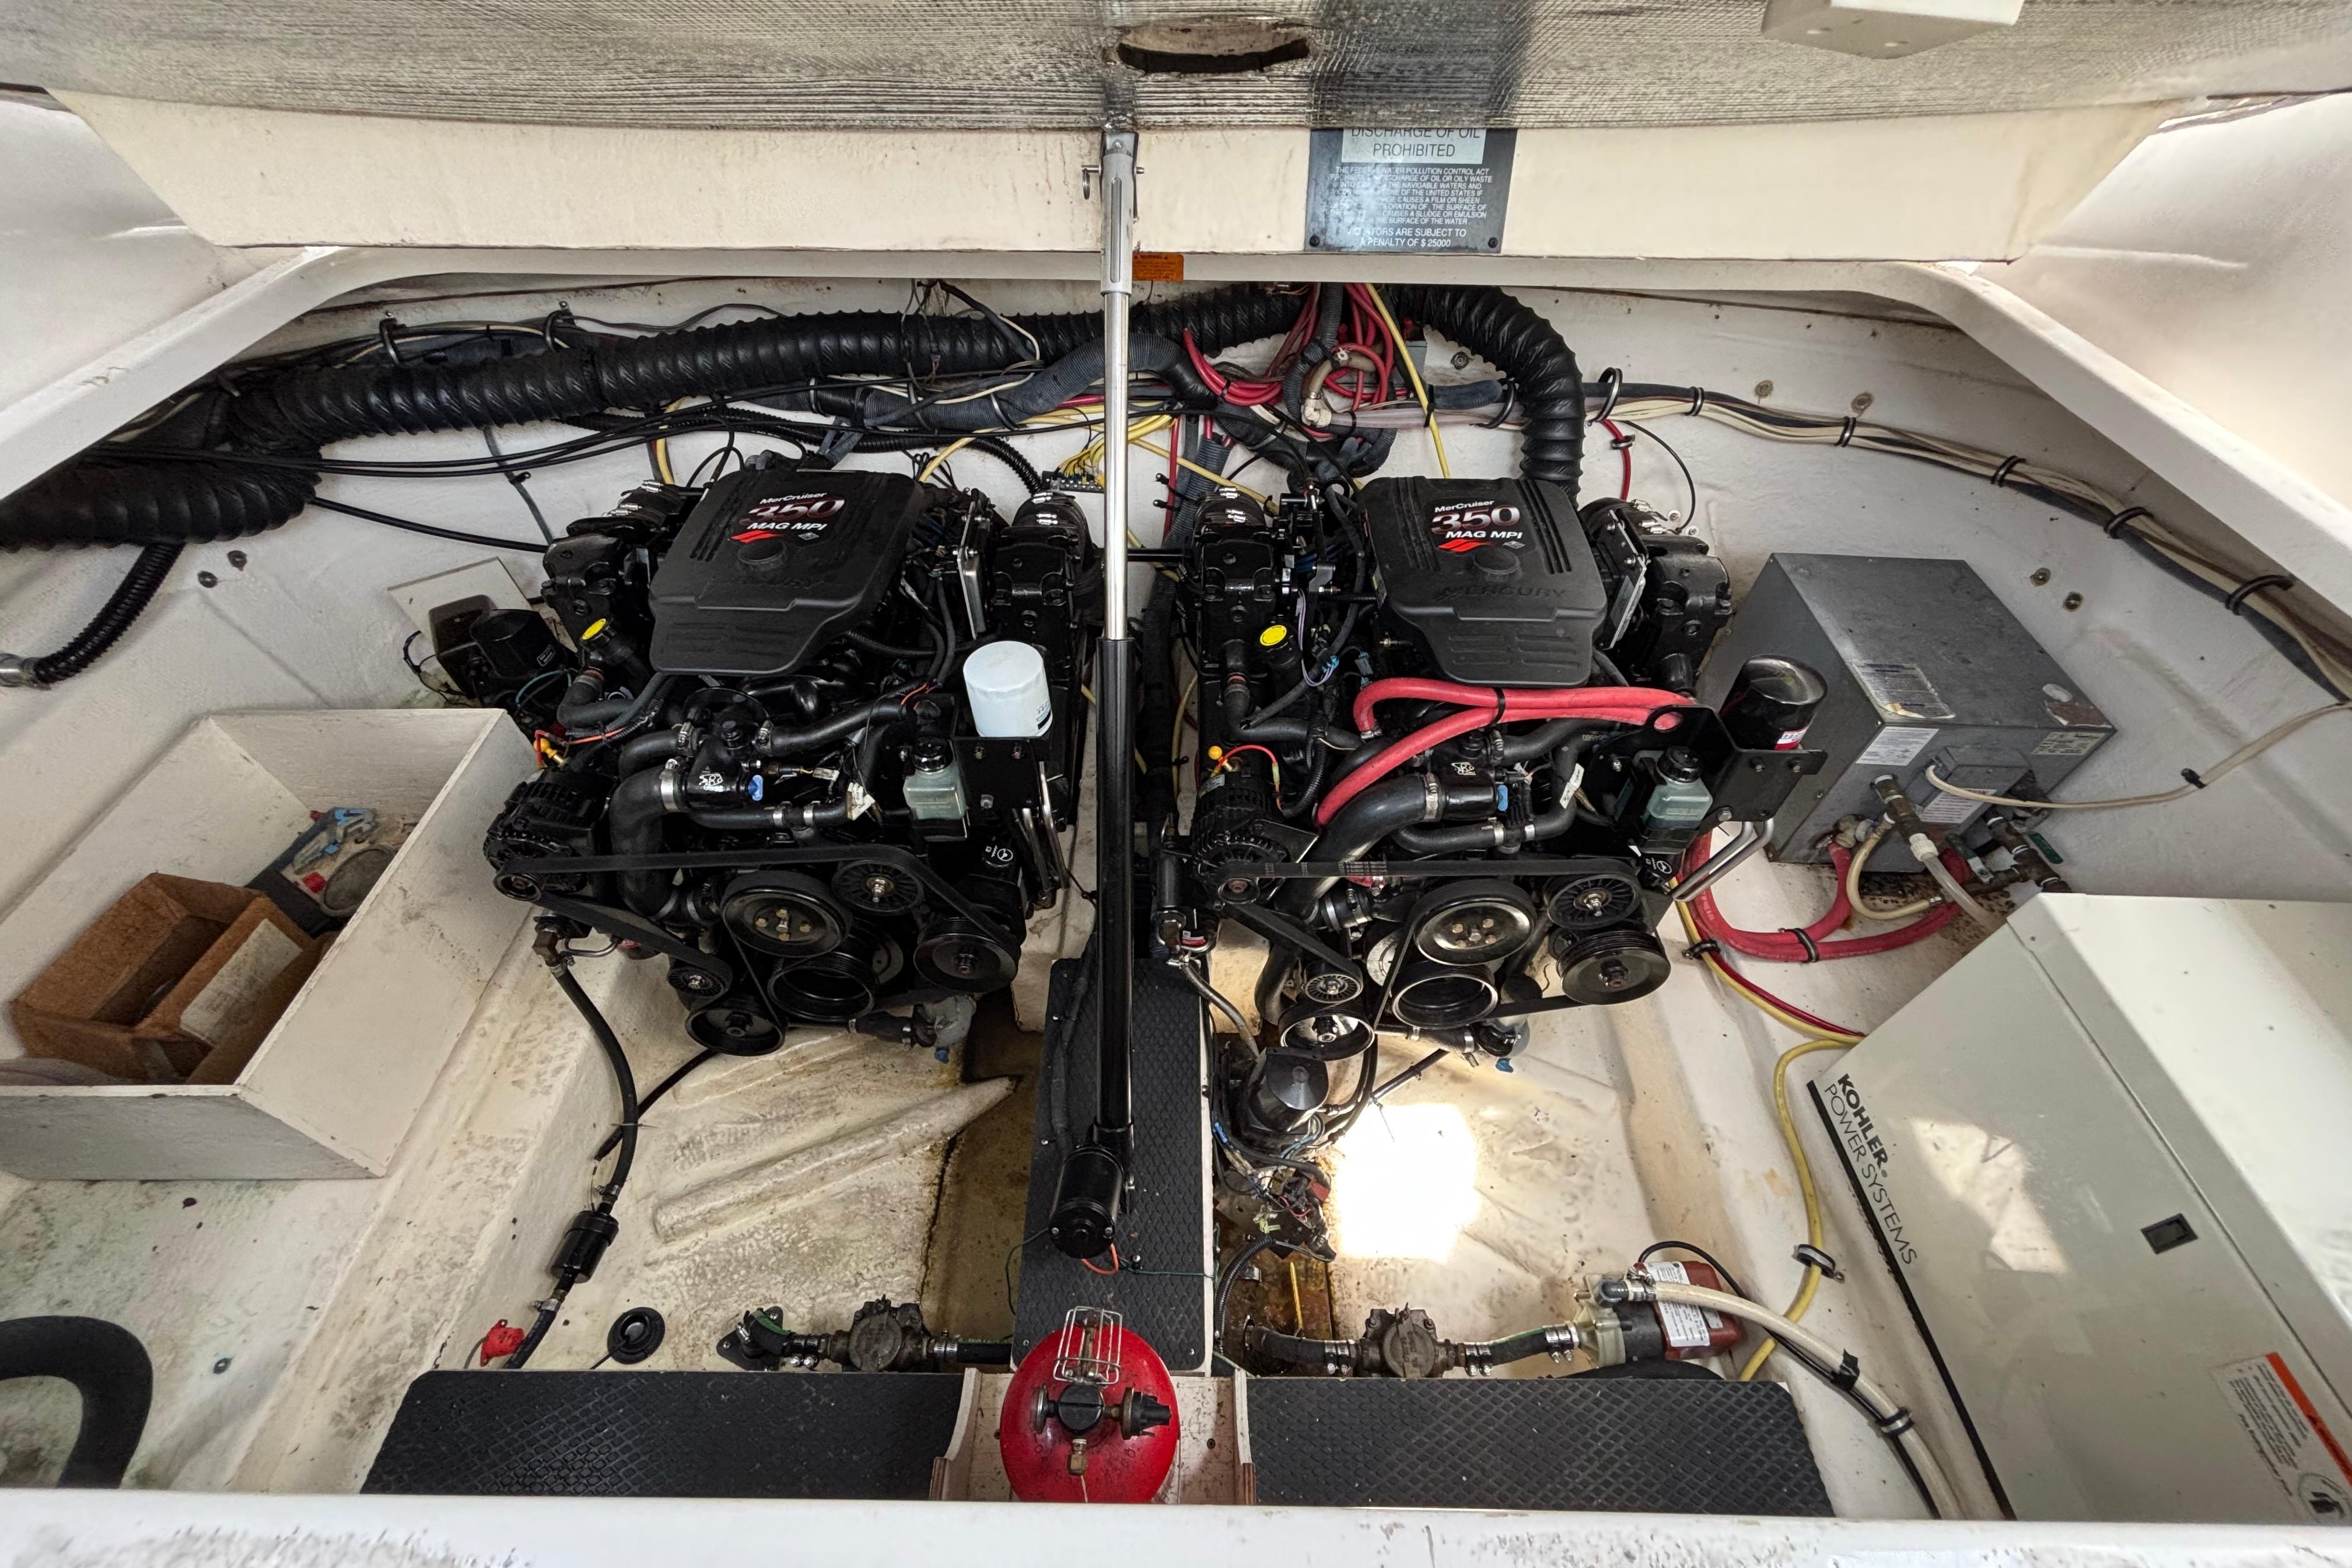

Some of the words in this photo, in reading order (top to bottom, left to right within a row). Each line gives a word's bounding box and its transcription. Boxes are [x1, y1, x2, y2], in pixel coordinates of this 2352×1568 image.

[1352, 128, 1431, 138] DISCHARGE
[1436, 128, 1457, 138] OF
[1459, 128, 1480, 138] OIL
[1373, 143, 1455, 157] PROHIBITED
[1395, 228, 1412, 236] ARE
[1415, 229, 1452, 237] SUBJECT
[1455, 229, 1466, 237] TO
[1368, 238, 1405, 246] PENALTY
[760, 492, 827, 505] MerCruiser
[739, 497, 846, 526] 350
[1434, 499, 1495, 513] MerCruiser
[1431, 504, 1521, 534] 350
[747, 522, 790, 530] MAG
[791, 522, 828, 531] MPI
[1445, 530, 1487, 539] MAG
[1490, 531, 1523, 540] MPI
[1824, 1083, 1867, 1163] POWER
[1861, 1164, 1917, 1265] SYSTEMS
